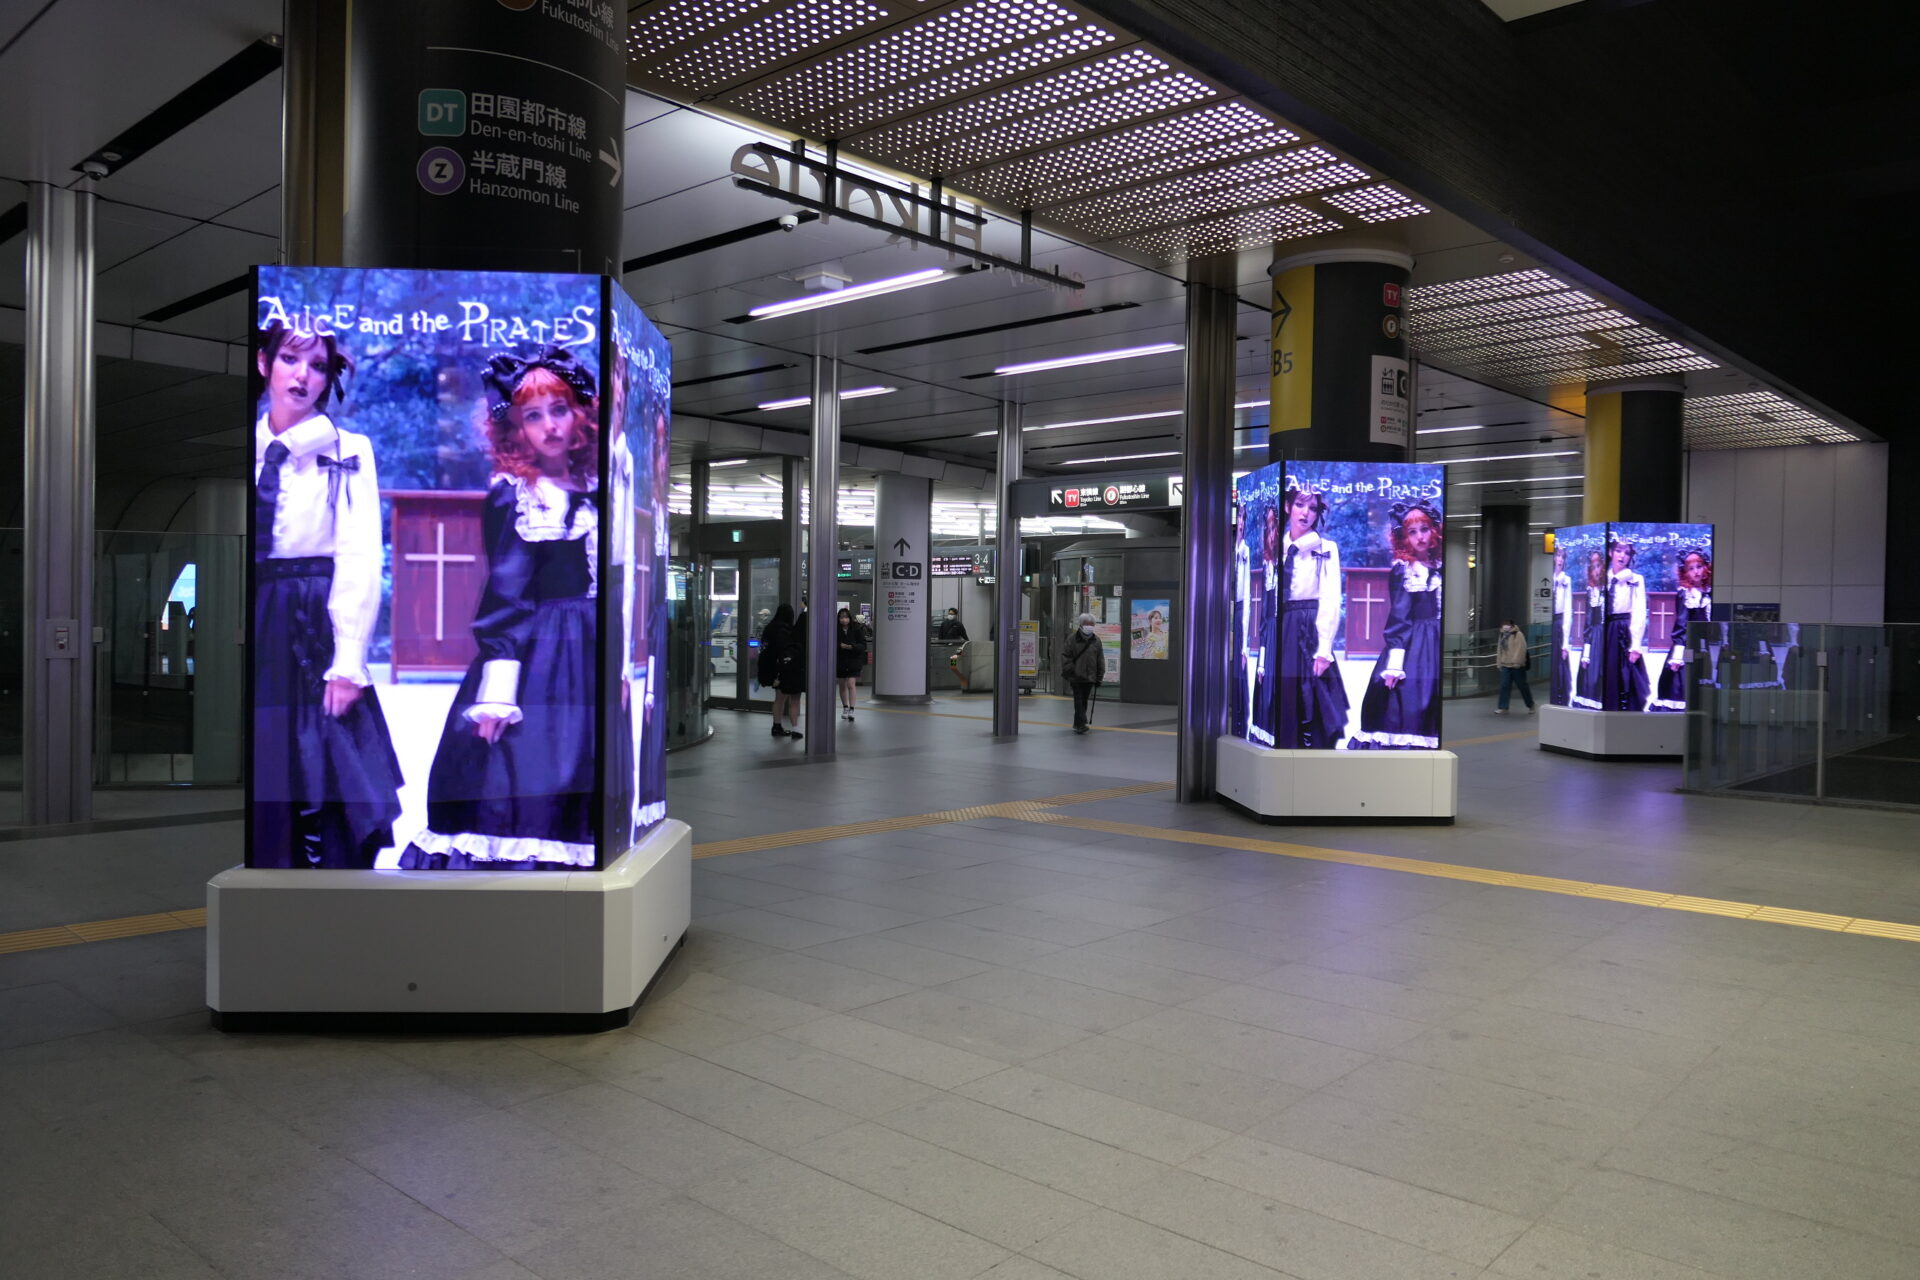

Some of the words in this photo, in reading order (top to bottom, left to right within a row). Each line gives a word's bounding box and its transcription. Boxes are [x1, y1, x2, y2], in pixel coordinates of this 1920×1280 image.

[542, 0, 604, 42] Fukutoshin
[605, 31, 620, 55] Line
[427, 103, 458, 122] DT
[471, 92, 587, 141] 田園都市線
[471, 121, 566, 153] Den-en-toshi
[569, 143, 592, 163] Line
[434, 163, 448, 179] Z
[470, 150, 567, 189] 半蔵門線
[470, 178, 550, 206] Hanzomon
[554, 193, 580, 214] Line
[1387, 289, 1399, 301] TY
[359, 313, 404, 335] and
[411, 311, 451, 332] the
[1273, 349, 1293, 377] B5
[1068, 494, 1077, 503] TY
[1332, 483, 1353, 494] and
[1355, 482, 1375, 493] the
